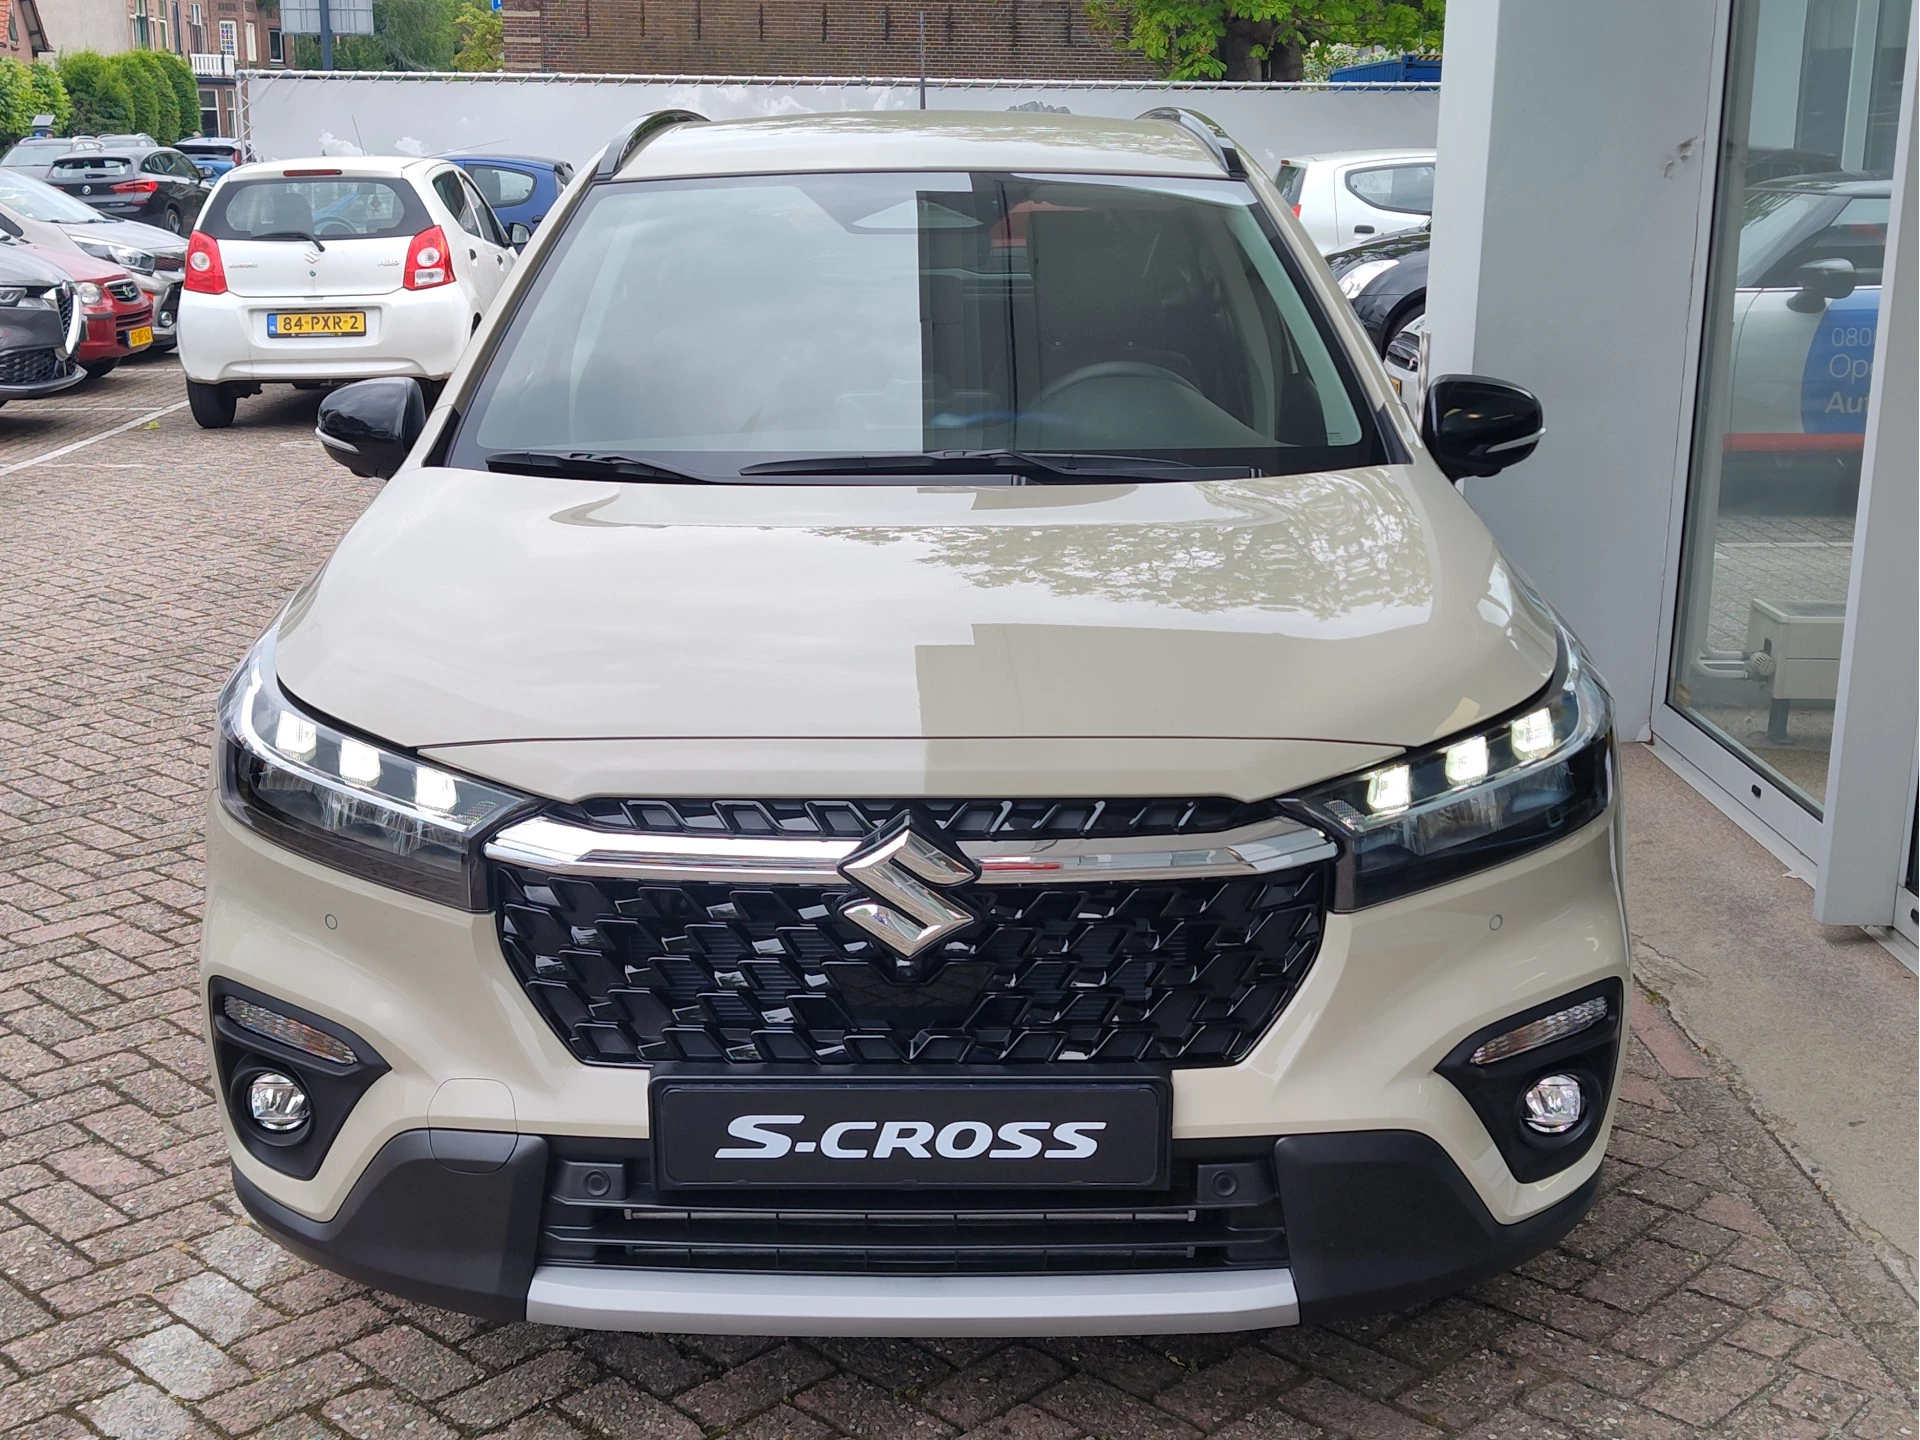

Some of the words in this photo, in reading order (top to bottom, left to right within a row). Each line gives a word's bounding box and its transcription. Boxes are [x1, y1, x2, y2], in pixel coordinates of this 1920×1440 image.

[283, 315, 359, 331] 84-PXR-2
[1831, 327, 1877, 347] 080
[1829, 353, 1874, 385] Op
[714, 1114, 1107, 1159] S-CROSS
